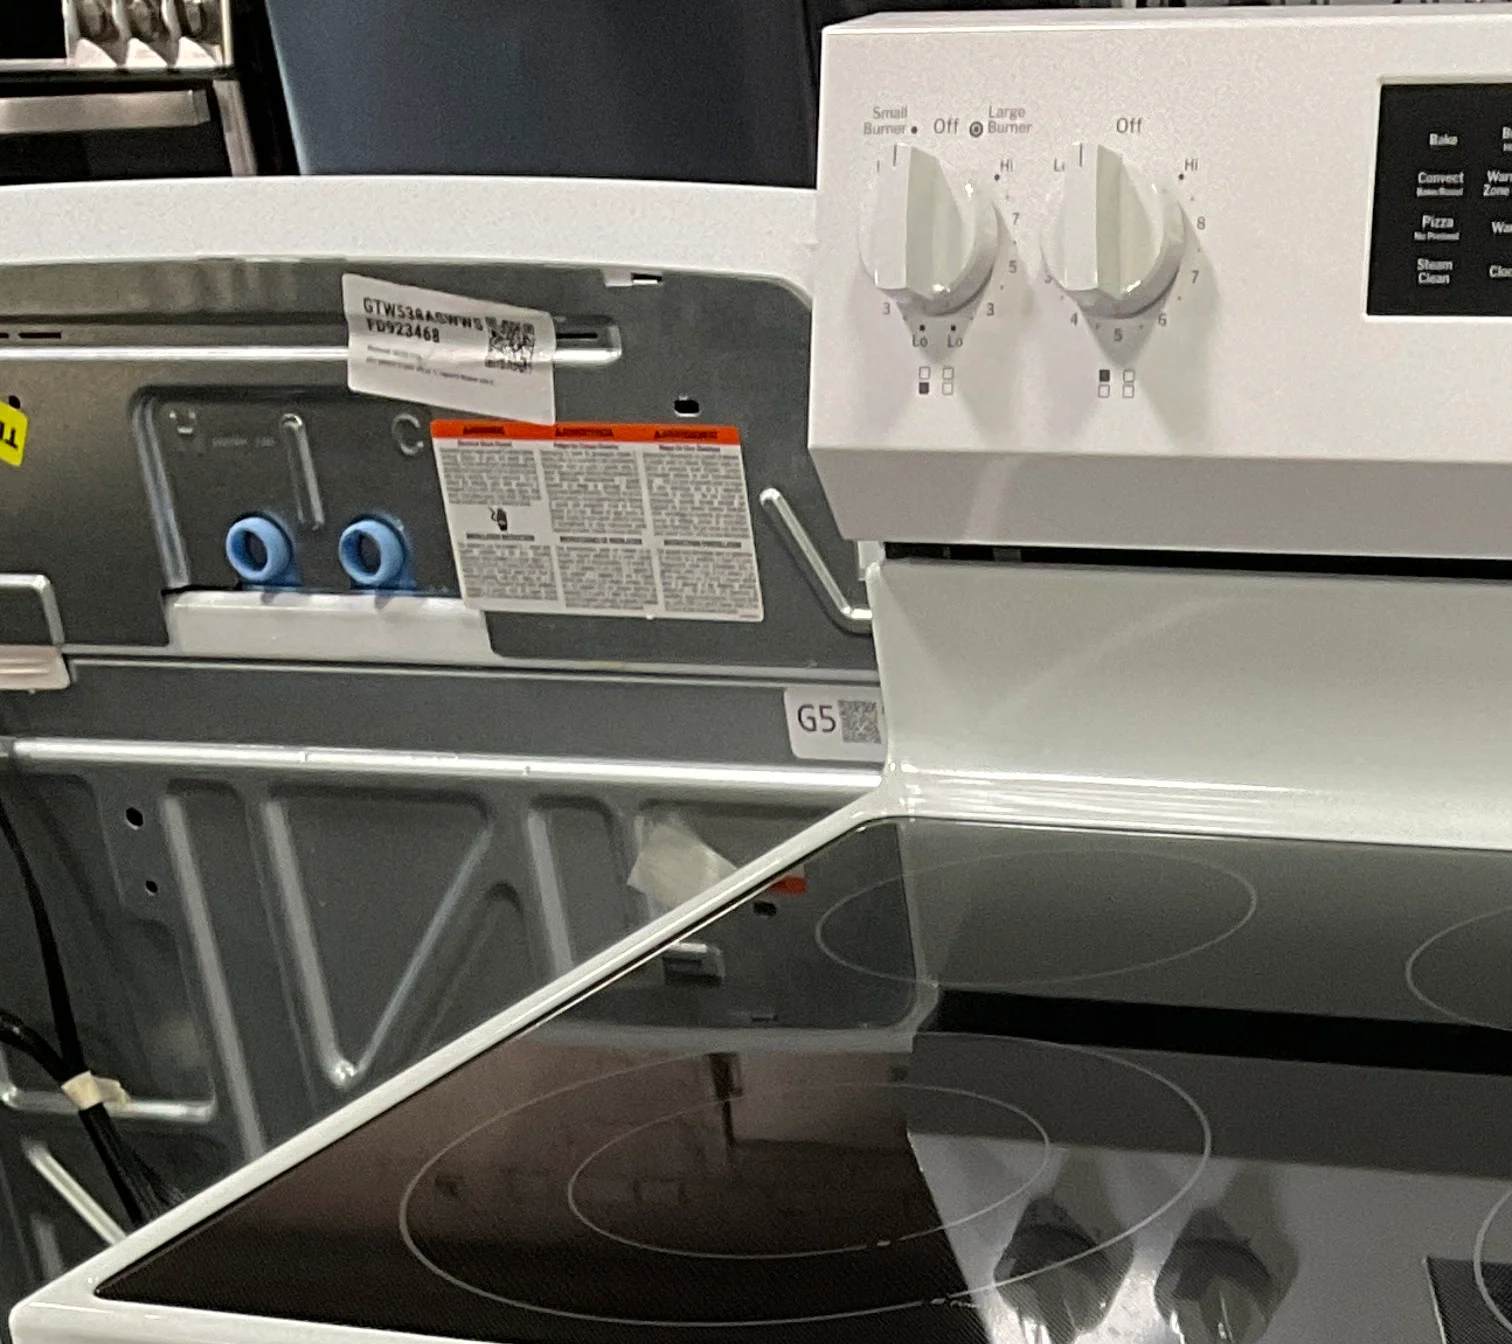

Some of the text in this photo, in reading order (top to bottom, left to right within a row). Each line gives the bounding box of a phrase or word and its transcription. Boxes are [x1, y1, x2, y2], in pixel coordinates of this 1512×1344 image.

[872, 106, 908, 120] Small
[988, 105, 1026, 121] Large
[863, 122, 906, 136] Burner
[933, 118, 960, 134] Off
[988, 121, 1033, 135] Burner
[1116, 118, 1142, 134] Off
[1429, 134, 1458, 146] Bake
[999, 159, 1014, 173] Hi
[1184, 158, 1199, 173] Hi
[1417, 172, 1464, 184] Convect
[1483, 184, 1510, 197] Zone
[1012, 212, 1020, 226] 7
[1196, 215, 1206, 231] 8
[1422, 215, 1454, 228] Pizza
[1008, 259, 1017, 274] 5
[1417, 258, 1454, 271] Steam
[1190, 269, 1200, 284] 7
[1418, 272, 1450, 285] Clean
[882, 301, 891, 316] 3
[985, 302, 995, 317] 3
[1070, 312, 1079, 328] 4
[1158, 312, 1168, 328] 6
[912, 334, 928, 349] Lo
[947, 334, 963, 349] Lo
[1113, 328, 1123, 343] 5
[797, 703, 837, 733] G5
